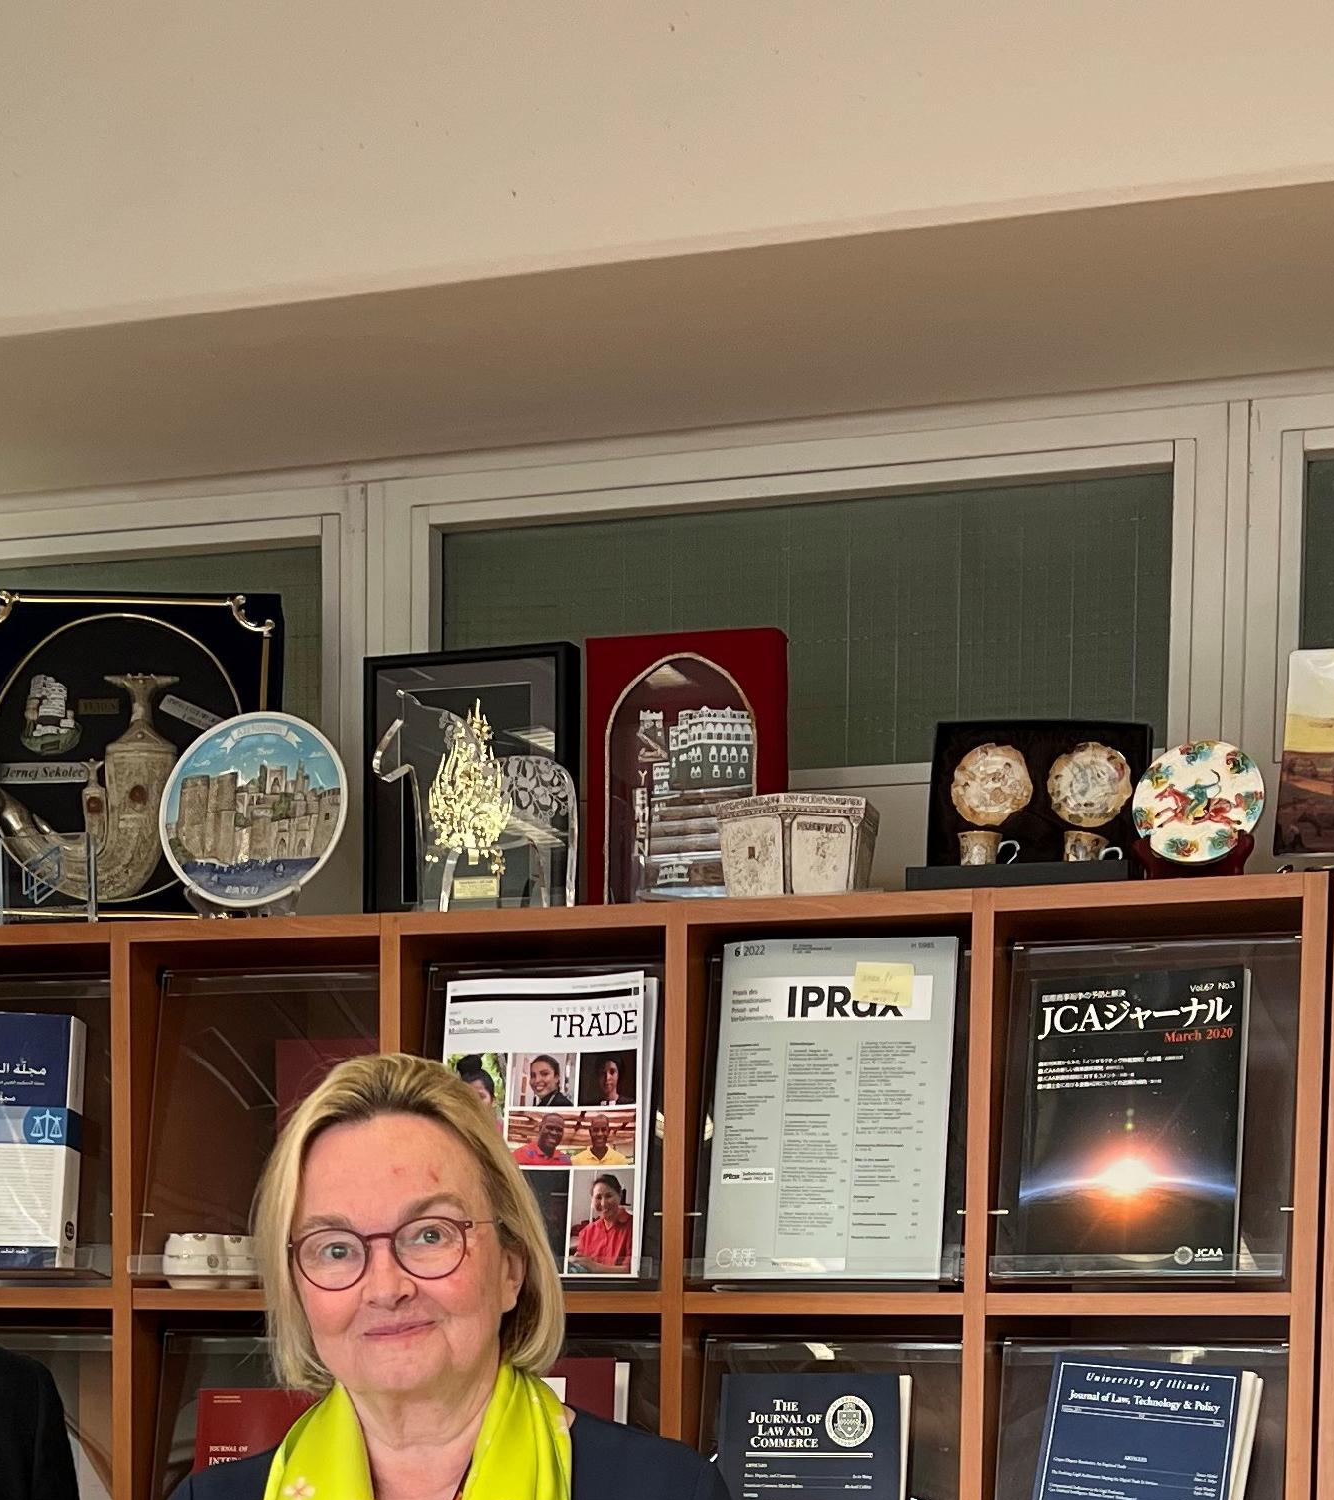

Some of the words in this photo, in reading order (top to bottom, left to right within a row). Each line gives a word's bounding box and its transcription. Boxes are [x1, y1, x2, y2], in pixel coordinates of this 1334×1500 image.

[3, 767, 38, 780] Jernej
[41, 766, 86, 778] Sekolec
[743, 944, 766, 957] 2022
[551, 1009, 638, 1038] TRADE
[1037, 996, 1233, 1040] JCAジャーナル
[1164, 1029, 1202, 1043] March
[1206, 1027, 1234, 1040] 2020
[1194, 1247, 1224, 1258] JCAA
[1086, 1371, 1146, 1389] University
[1149, 1377, 1164, 1391] of
[1166, 1378, 1211, 1393] Illinois
[773, 1399, 799, 1412] THE
[1069, 1389, 1101, 1403] Journal
[1101, 1391, 1111, 1403] of
[1111, 1392, 1132, 1406] Law,
[1134, 1394, 1181, 1411] Technology
[1183, 1399, 1193, 1410] &
[1194, 1400, 1221, 1415] Policy
[747, 1411, 804, 1425] JOURNAL
[806, 1414, 822, 1425] OF
[757, 1425, 785, 1437] LAW
[787, 1427, 813, 1437] AND
[750, 1436, 819, 1449] COMMERCE
